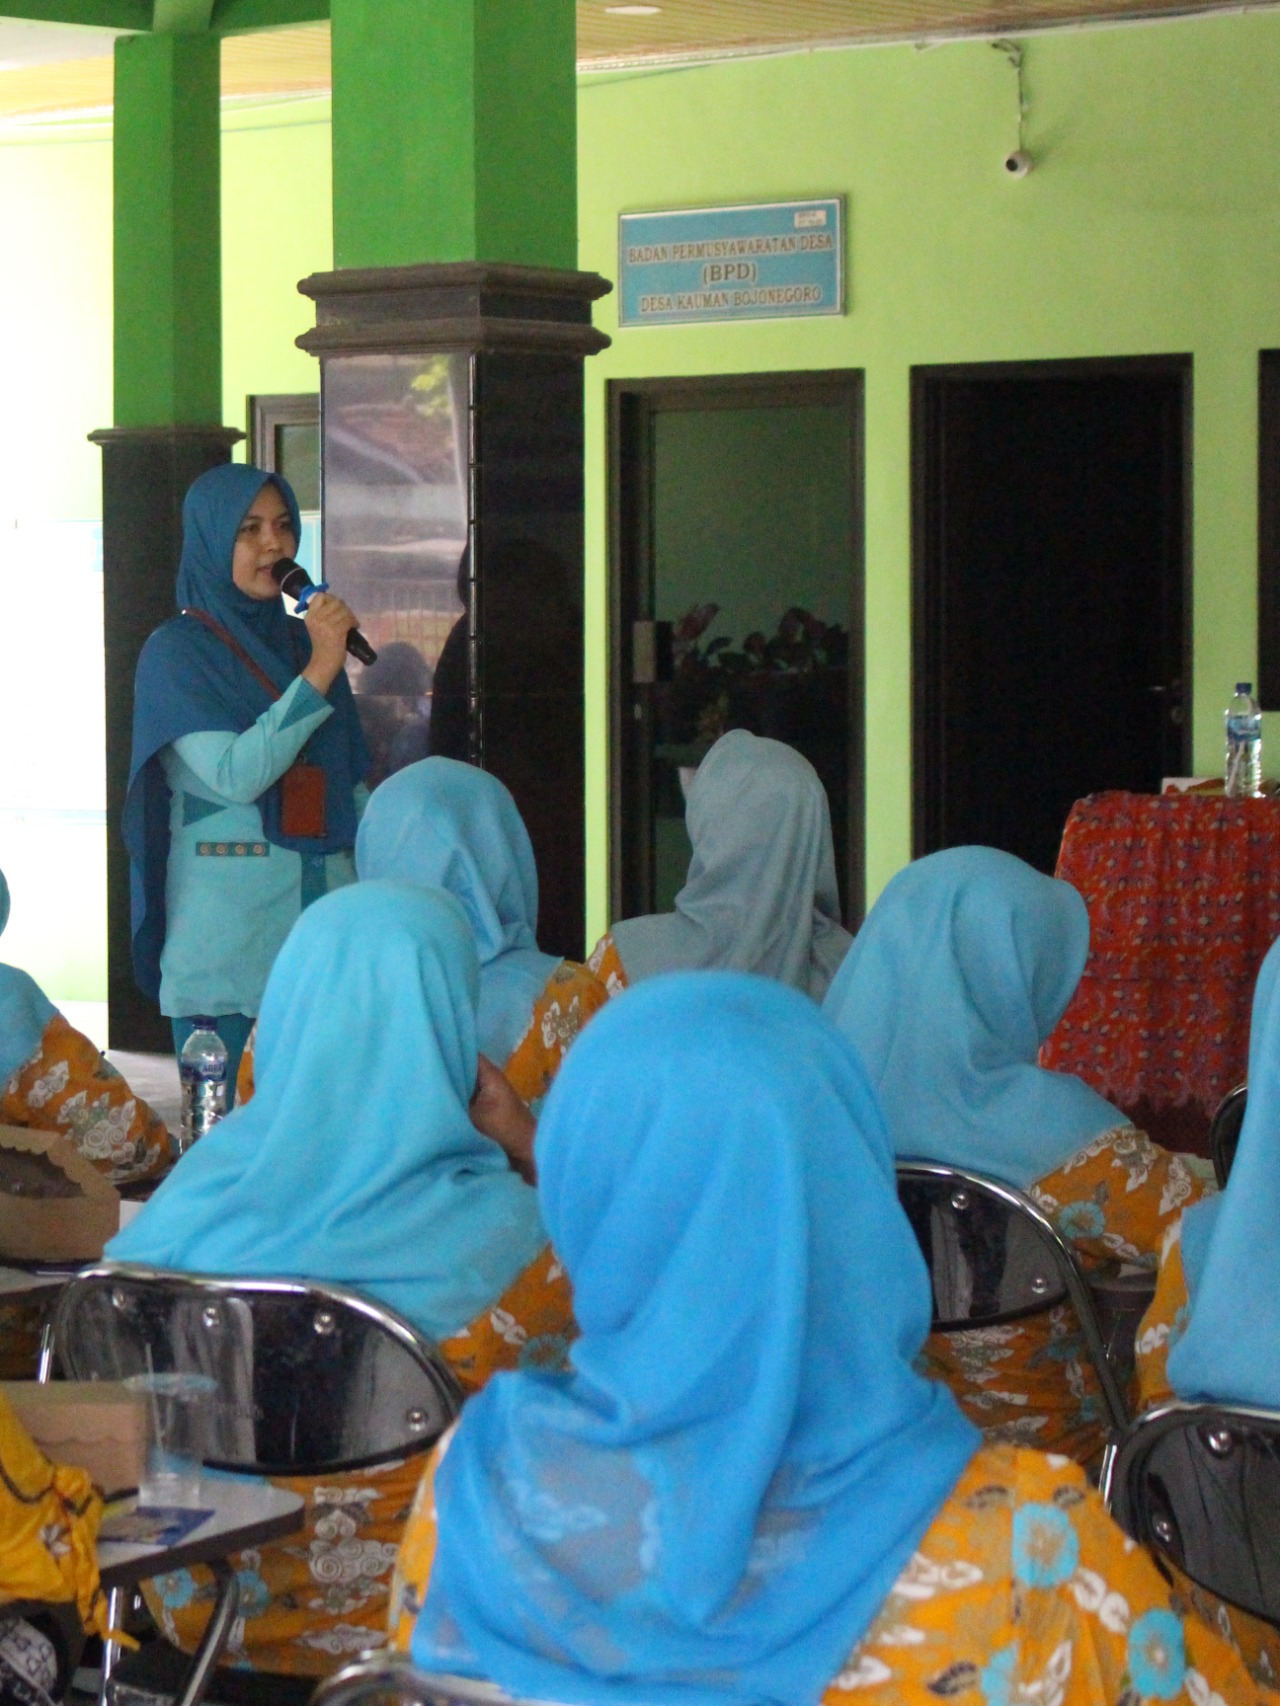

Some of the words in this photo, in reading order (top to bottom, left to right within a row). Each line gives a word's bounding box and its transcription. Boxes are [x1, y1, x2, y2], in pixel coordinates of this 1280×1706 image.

[628, 245, 668, 264] BADAN
[671, 235, 797, 261] PERMUSYAWARATAN
[800, 233, 833, 251] DESA
[702, 262, 757, 287] (BPD)
[640, 295, 673, 313] DESA
[677, 291, 729, 310] KAUMAN
[733, 286, 822, 307] BOJONEGORO
